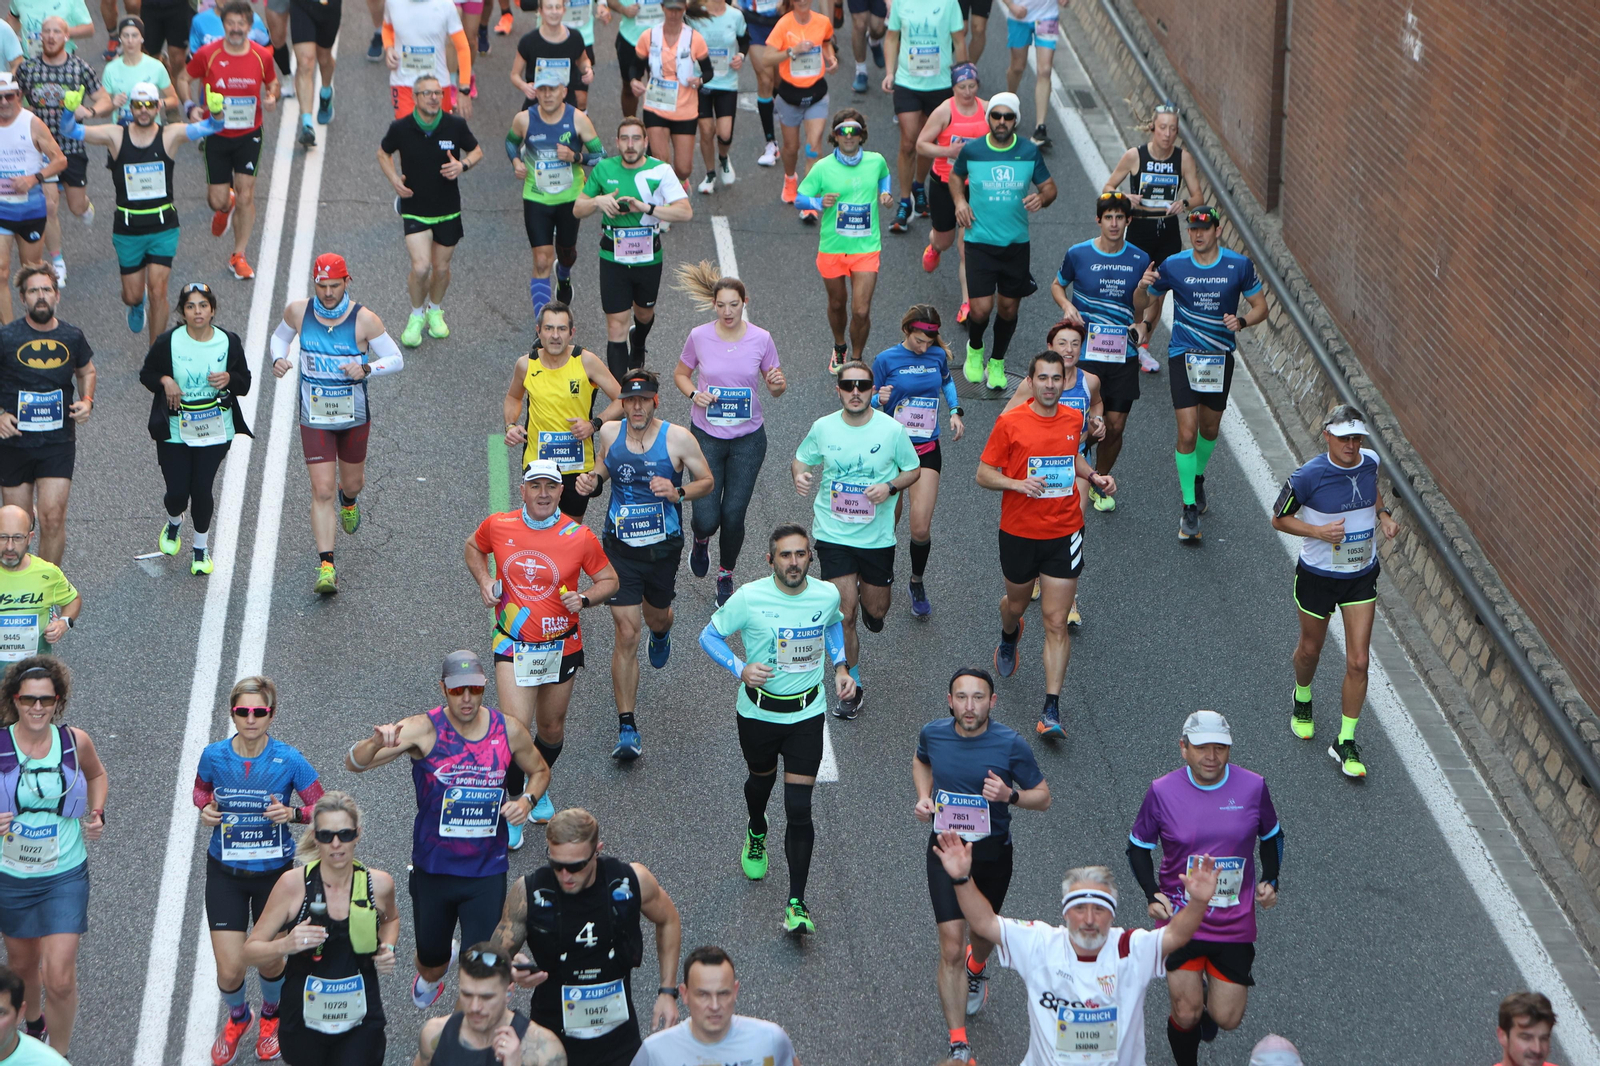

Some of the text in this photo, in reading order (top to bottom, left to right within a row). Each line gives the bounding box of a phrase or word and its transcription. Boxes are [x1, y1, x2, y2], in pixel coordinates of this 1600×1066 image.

[548, 161, 567, 169] ZURICH
[1146, 162, 1174, 173] SOPH
[996, 168, 1010, 181] 34
[1103, 264, 1134, 272] HYUNDAI
[1100, 278, 1126, 286] Hyundai
[1196, 276, 1228, 284] HYUNDAI
[325, 388, 348, 396] ZURICH
[36, 394, 58, 402] ZURICH
[194, 411, 216, 419] ZURICH
[1349, 532, 1371, 541] ZURICH
[456, 778, 487, 786] SPORTING
[952, 798, 981, 806] ZURICH
[25, 828, 51, 838] ZURICH
[240, 831, 263, 839] 12713
[20, 844, 42, 853] 10727
[19, 855, 41, 863] NICOLE
[575, 922, 598, 948] 4
[326, 980, 357, 992] ZURICH
[585, 986, 616, 998] ZURICH
[324, 1001, 348, 1009] 10729
[584, 1006, 608, 1015] 10476
[1078, 1012, 1111, 1021] ZURICH
[1075, 1031, 1100, 1040] 10109
